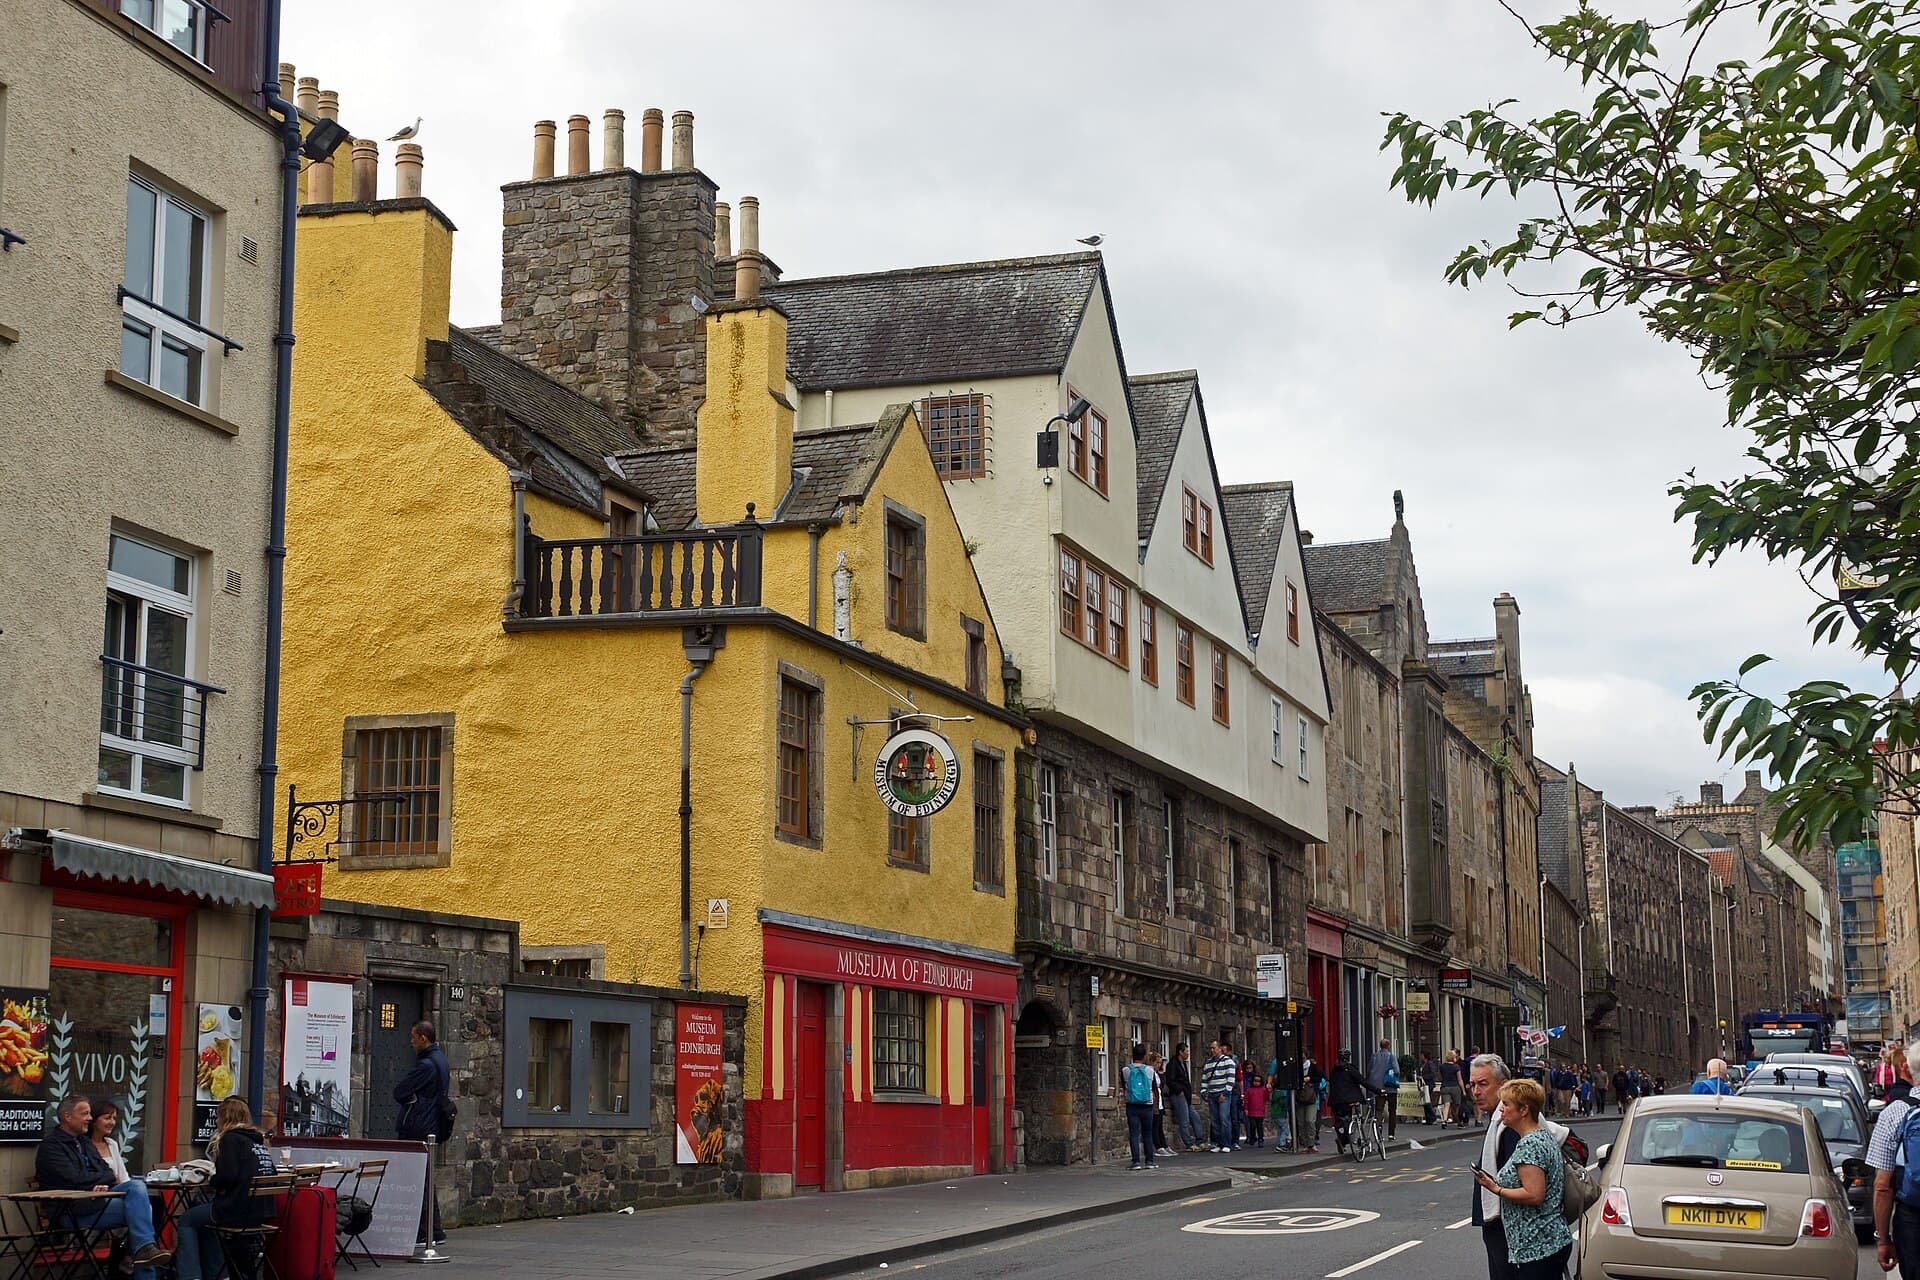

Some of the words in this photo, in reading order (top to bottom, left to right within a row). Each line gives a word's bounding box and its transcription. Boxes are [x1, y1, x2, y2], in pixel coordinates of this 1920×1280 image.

[1842, 578, 1850, 588] 8
[876, 759, 897, 807] MUSEUM
[898, 803, 911, 815] OF
[915, 759, 956, 816] EDINBURGH
[837, 950, 897, 979] MUSEUM
[902, 958, 919, 982] OF
[922, 962, 973, 991] EDINBURGH
[451, 986, 464, 999] 140
[686, 1022, 716, 1034] MUSEUM
[680, 1042, 721, 1055] EDINBURGH
[75, 1052, 125, 1083] VIVO
[0, 1109, 44, 1119] RADITIONAL
[13, 1121, 19, 1130] &
[20, 1121, 42, 1130] CHIPS
[1215, 1215, 1347, 1227] 20
[1681, 1208, 1711, 1223] NK11
[1716, 1210, 1747, 1226] DVK
